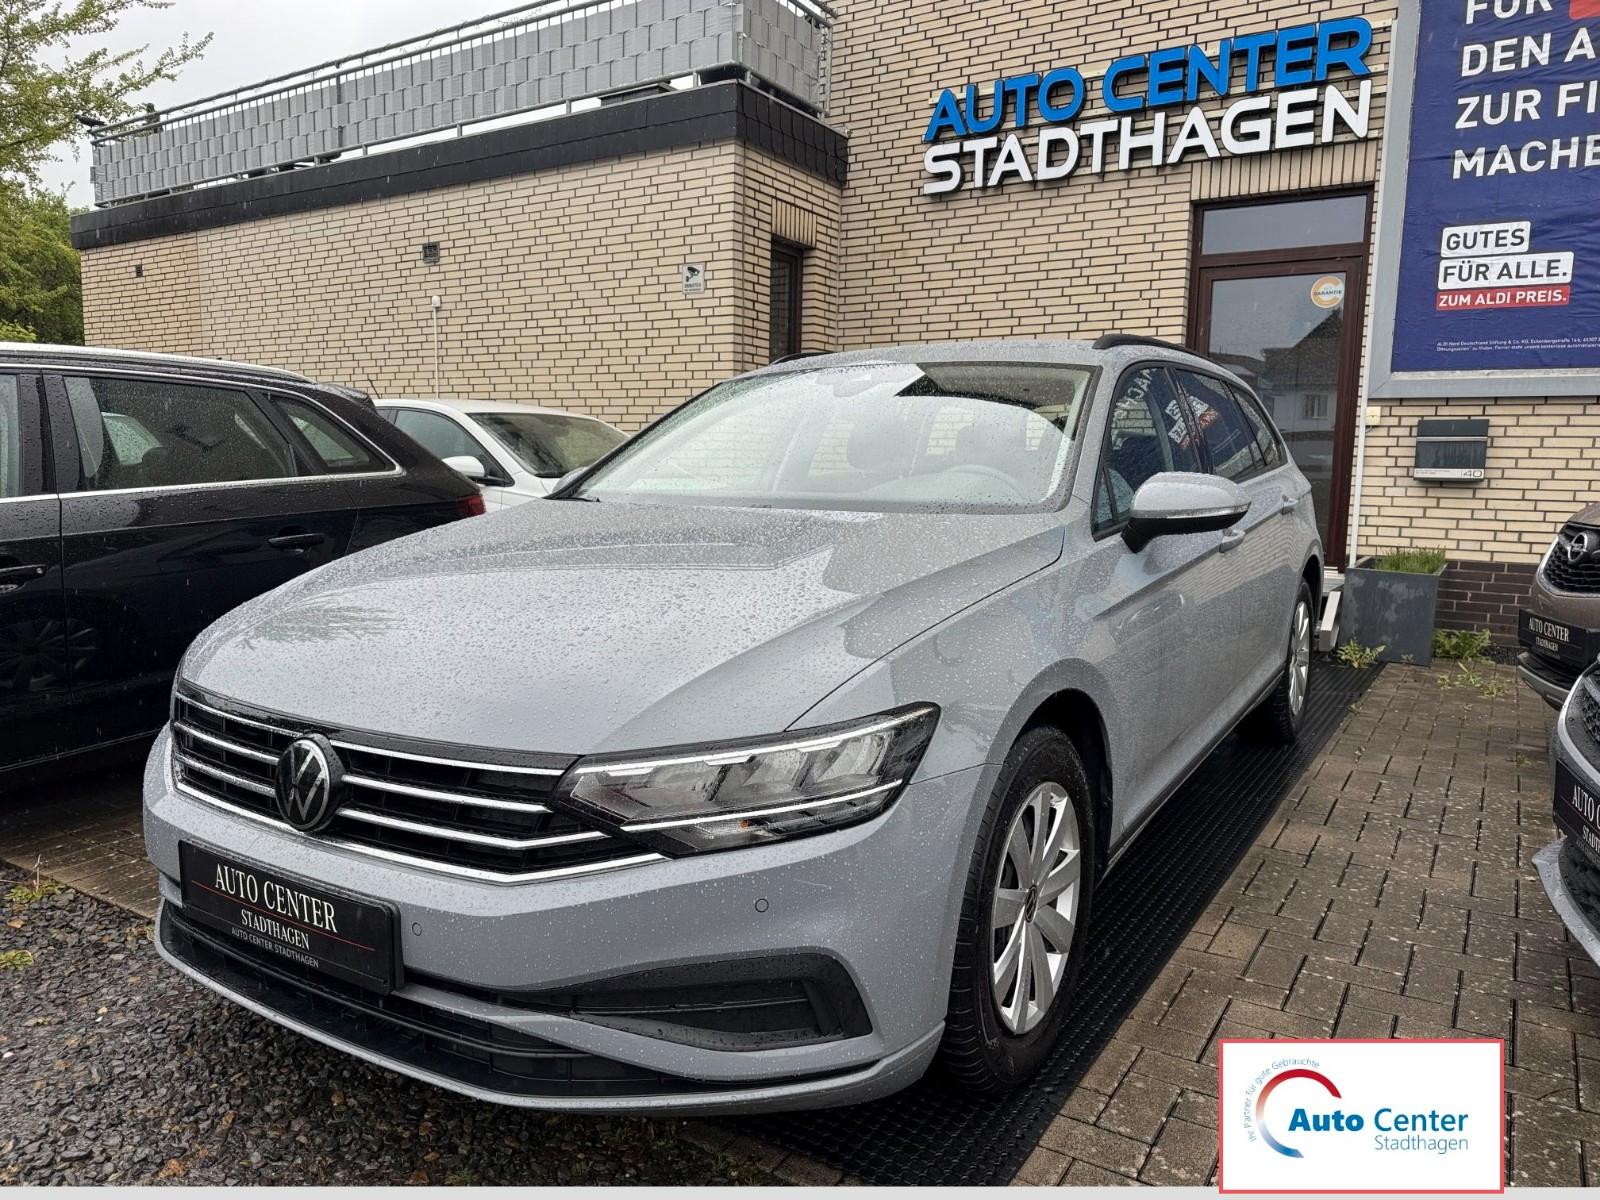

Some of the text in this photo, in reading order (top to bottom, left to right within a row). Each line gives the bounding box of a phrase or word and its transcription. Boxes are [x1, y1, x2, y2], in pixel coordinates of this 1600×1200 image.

[1461, 32, 1552, 77] DEN
[923, 16, 1374, 142] AUTO CENTER
[1455, 80, 1599, 129] ZUR FI
[923, 79, 1373, 195] STADTHAGEN
[1452, 134, 1600, 180] MACHE
[1446, 228, 1525, 251] GUTES
[1443, 259, 1568, 283] FÜR ALLE.
[1438, 289, 1567, 307] ZUM ALDI PREIS.
[1544, 621, 1570, 642] CENTER
[1572, 784, 1594, 821] AUTO
[215, 863, 339, 933] AUTO CENTER
[231, 927, 319, 968] AUTO CENTER STADTHAGEN
[240, 909, 310, 950] STADTHAGEN
